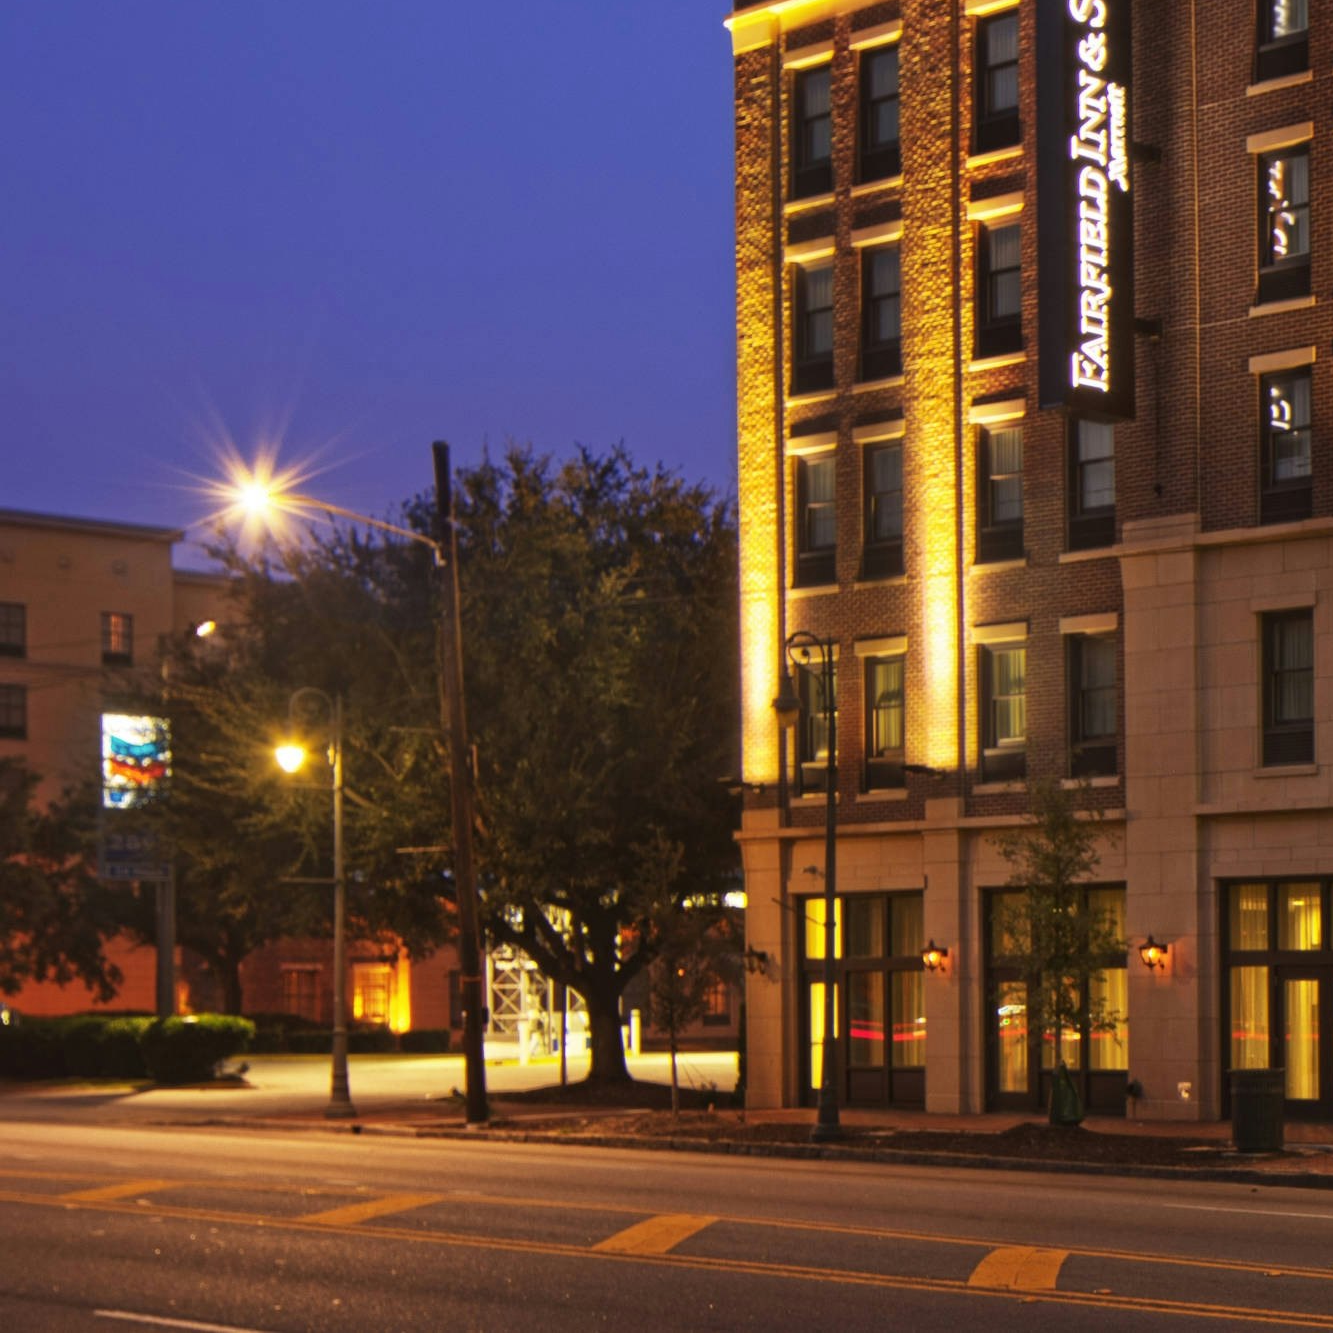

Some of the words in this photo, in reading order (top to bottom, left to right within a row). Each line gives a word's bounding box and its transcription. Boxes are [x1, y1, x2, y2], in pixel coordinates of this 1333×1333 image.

[1077, 32, 1107, 72] &
[1070, 69, 1108, 167] INN
[1106, 82, 1129, 192] Marriott
[1071, 166, 1112, 392] FAIRFIELD
